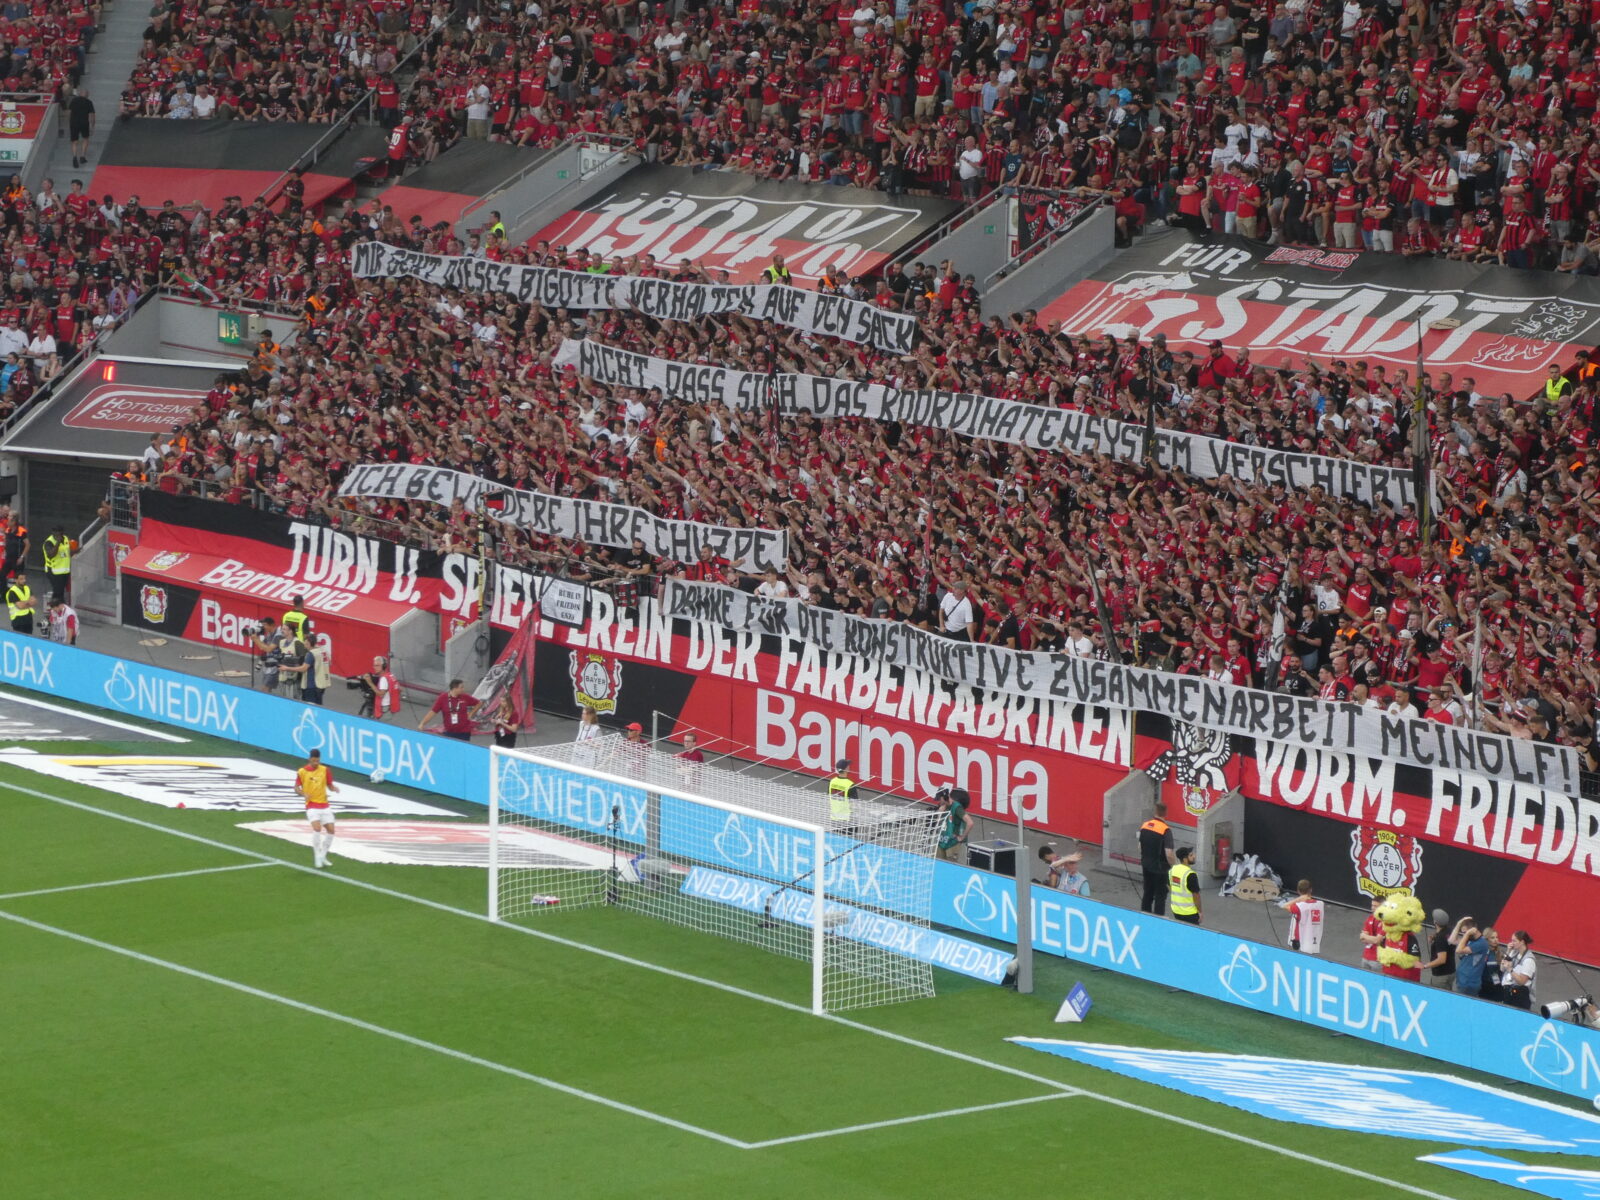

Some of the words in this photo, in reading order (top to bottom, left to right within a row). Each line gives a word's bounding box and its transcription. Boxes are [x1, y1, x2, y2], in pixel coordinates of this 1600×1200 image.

[1159, 242, 1253, 275] FÜR
[353, 243, 386, 275] MIR
[443, 256, 511, 293] DIESES
[518, 267, 621, 308] BIGOTTE
[628, 278, 755, 320] VERHALTEN
[761, 285, 806, 322] AUF
[812, 294, 852, 335] DEN
[855, 306, 915, 355] SACK
[1179, 279, 1534, 362] STADT
[91, 408, 186, 425] SOFTWARE
[579, 340, 649, 388] NICHT
[665, 363, 727, 402] DASS
[811, 376, 870, 418] DAS
[342, 465, 402, 495] ICH
[573, 499, 650, 545] IHRE
[200, 558, 358, 612] Barmenia
[138, 673, 239, 735] NIEDAX
[285, 521, 382, 595] TURN
[389, 544, 421, 604] U.
[686, 619, 759, 683] DER
[1255, 739, 1407, 828] VORM.
[669, 582, 734, 631] DANKE
[799, 608, 834, 650] DIE
[844, 617, 1036, 692] KONSTRUKTIVE
[1049, 652, 1364, 748] ZUSAMMENARBEIT
[1381, 714, 1573, 792] MEINOLF!
[328, 720, 436, 785] NIEDAX
[755, 686, 1051, 826] Barmenia
[532, 771, 648, 836] NIEDAX
[1372, 858, 1400, 872] BAYER
[684, 867, 767, 909] NIEDAX
[849, 912, 923, 955] NIEDAX
[931, 937, 1008, 981] NIEDAX
[1272, 960, 1429, 1048] NIEDAX
